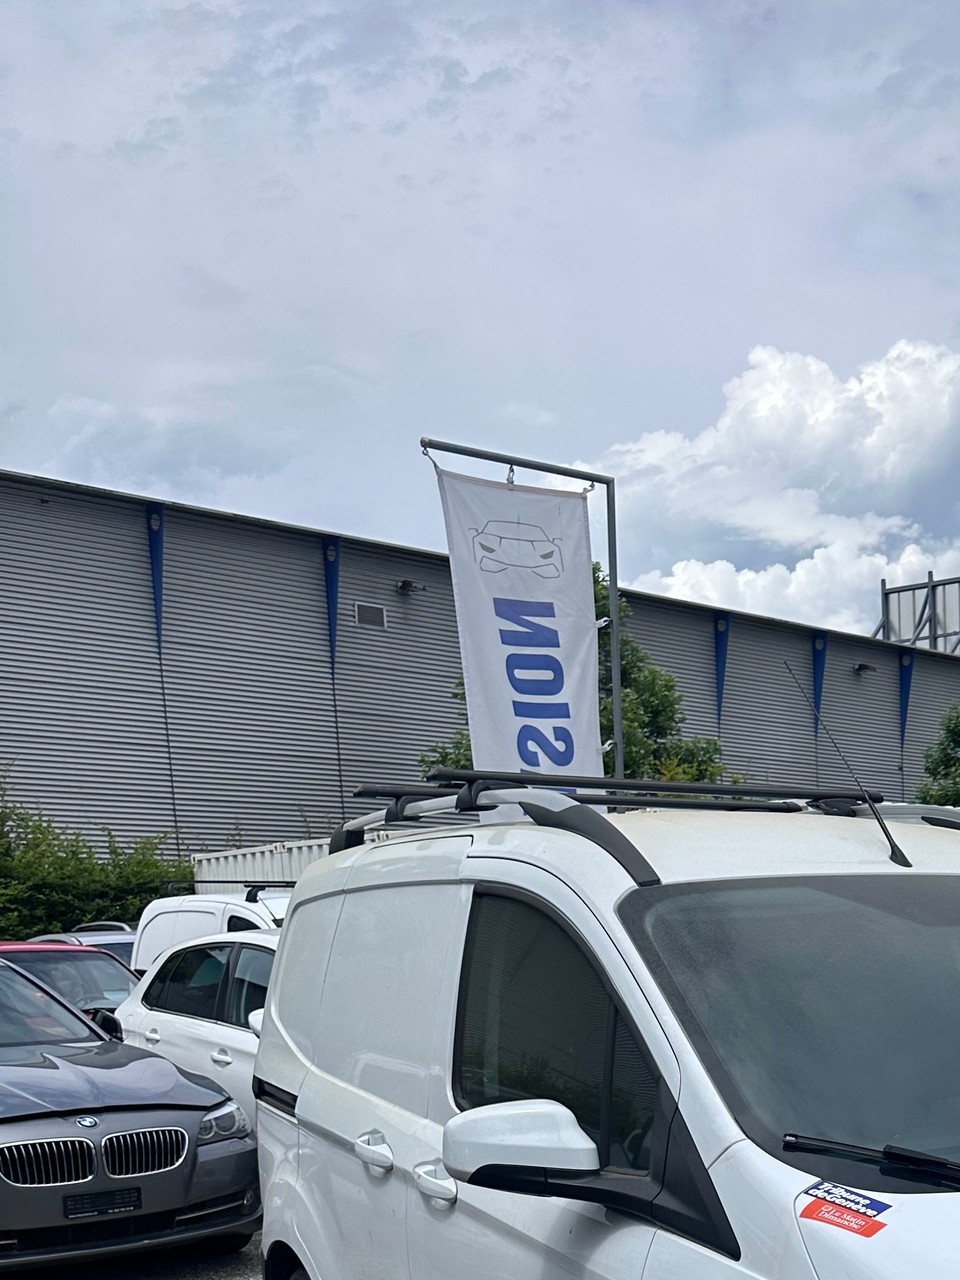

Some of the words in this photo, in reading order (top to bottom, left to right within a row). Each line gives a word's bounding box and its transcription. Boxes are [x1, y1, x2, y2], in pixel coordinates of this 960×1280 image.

[818, 1182, 871, 1205] Tribune
[819, 1211, 862, 1230] Dimanche
[843, 1213, 866, 1226] Matin
